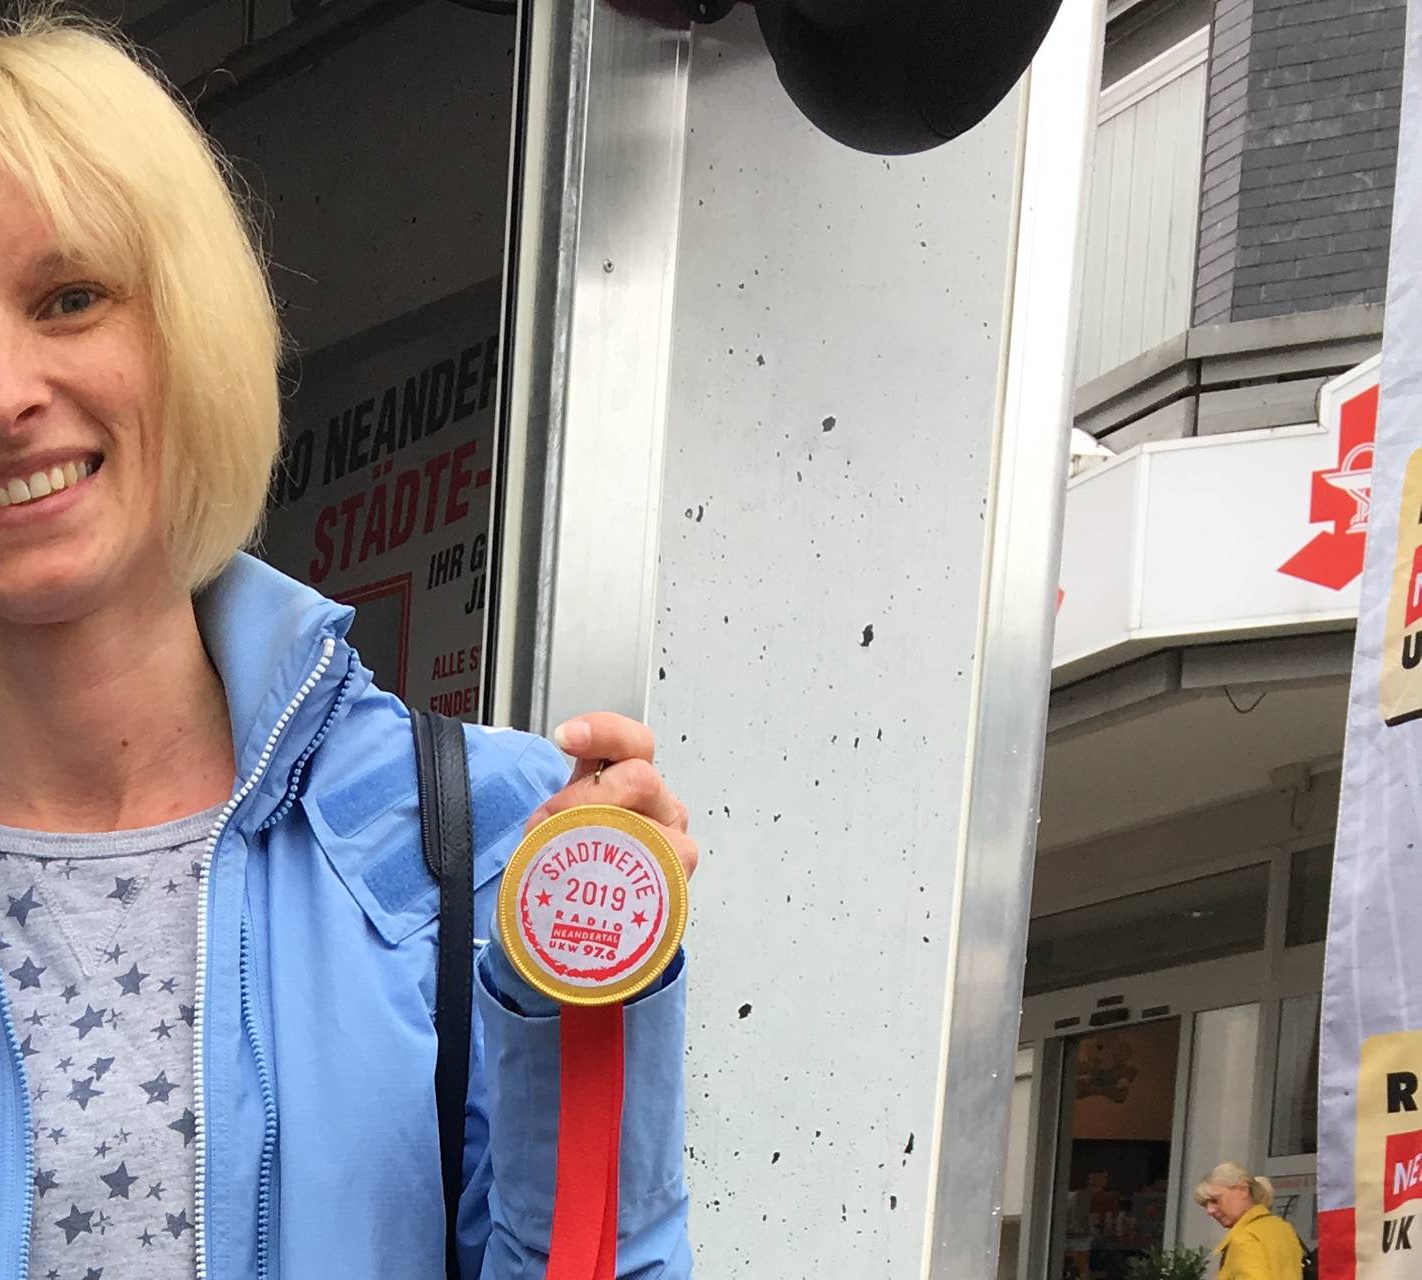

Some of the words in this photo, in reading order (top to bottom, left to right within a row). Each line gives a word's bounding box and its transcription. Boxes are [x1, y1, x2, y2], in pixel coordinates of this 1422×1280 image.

[310, 440, 491, 583] STÄDTE-
[427, 543, 465, 590] IHR
[470, 533, 486, 572] G
[432, 649, 465, 681] ALLE
[469, 644, 483, 672] S
[430, 686, 480, 717] FINDET
[542, 841, 656, 900] STADTWETTE
[566, 878, 626, 912] 2019
[553, 926, 619, 943] NEANDERTAL
[555, 910, 623, 932] RADIO
[549, 941, 579, 953] UKW
[583, 945, 616, 961] 97.6
[1393, 1153, 1422, 1195] NE
